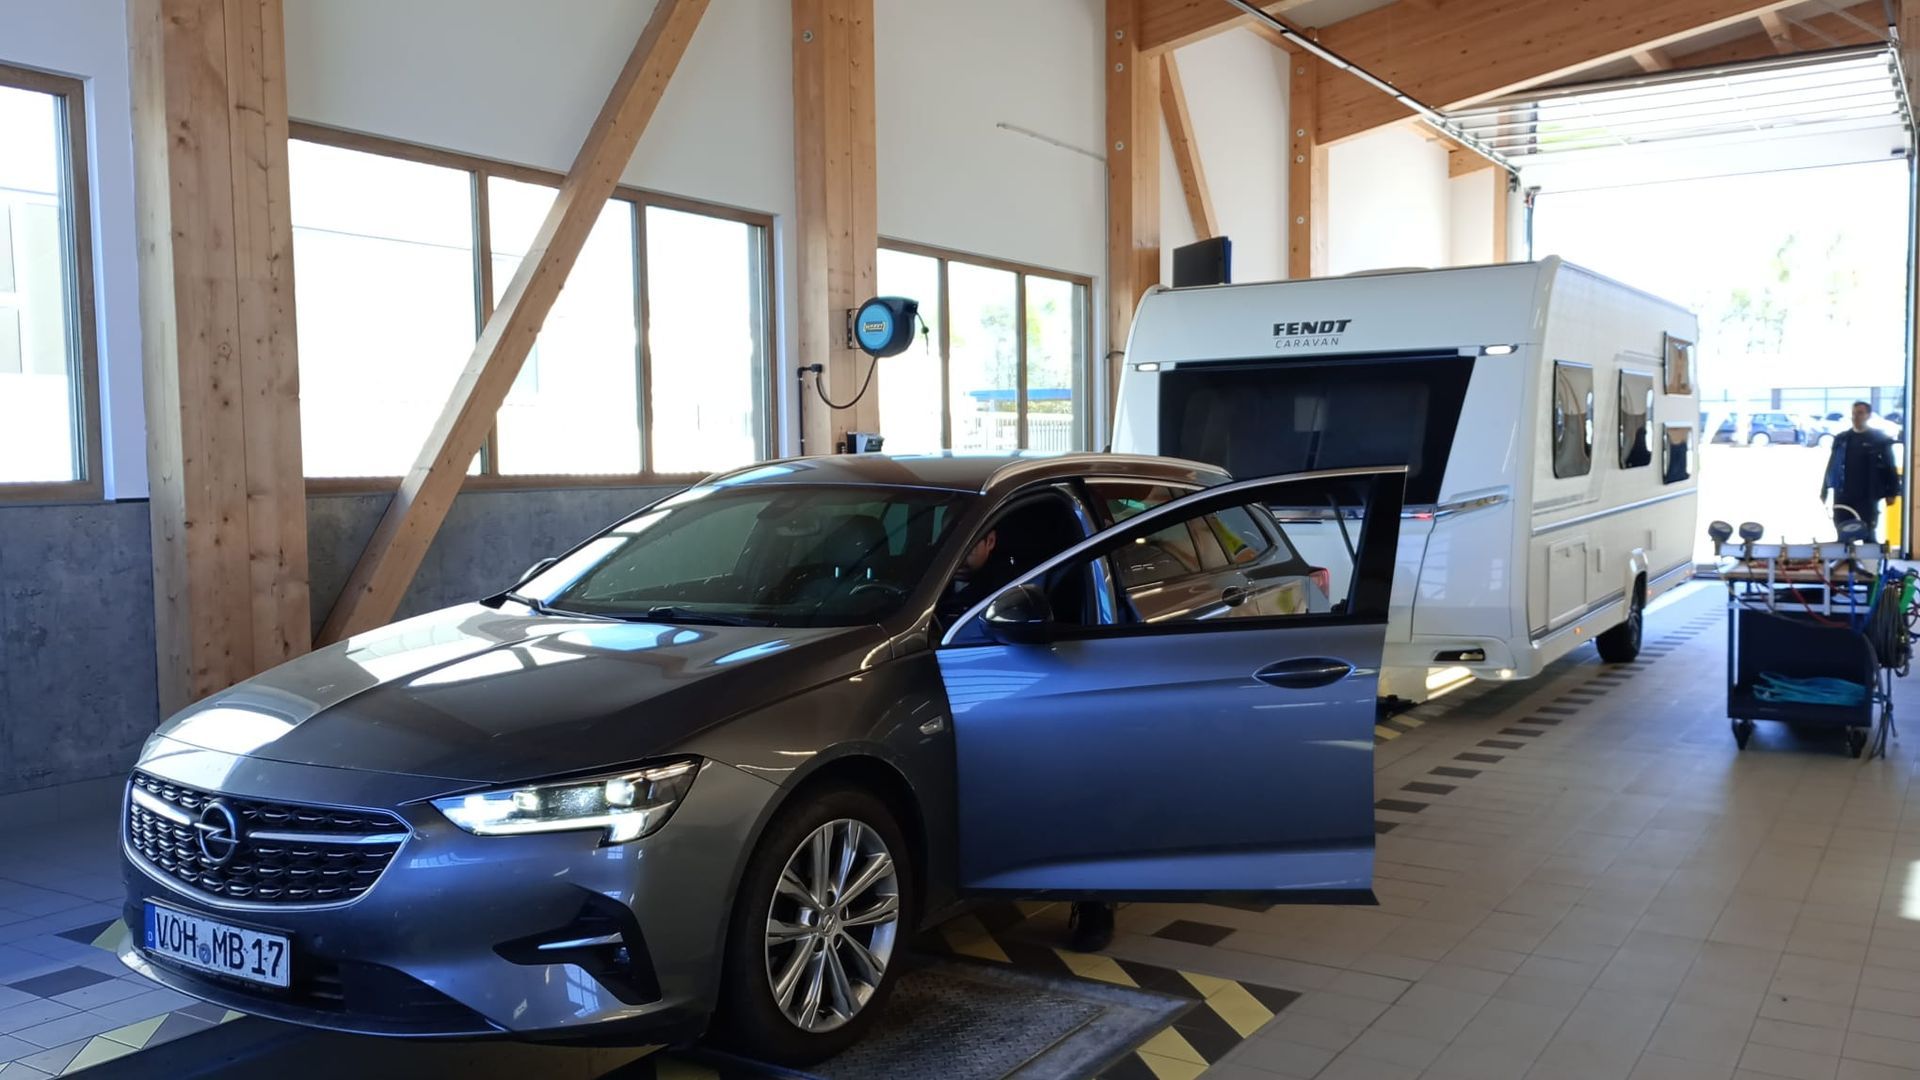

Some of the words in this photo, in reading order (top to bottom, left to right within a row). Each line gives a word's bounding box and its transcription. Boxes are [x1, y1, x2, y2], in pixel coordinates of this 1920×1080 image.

[1273, 319, 1352, 336] FENDT
[1275, 338, 1339, 349] CARAVAN
[156, 912, 197, 958] VOH
[212, 928, 244, 970] MB
[251, 938, 284, 977] 17
